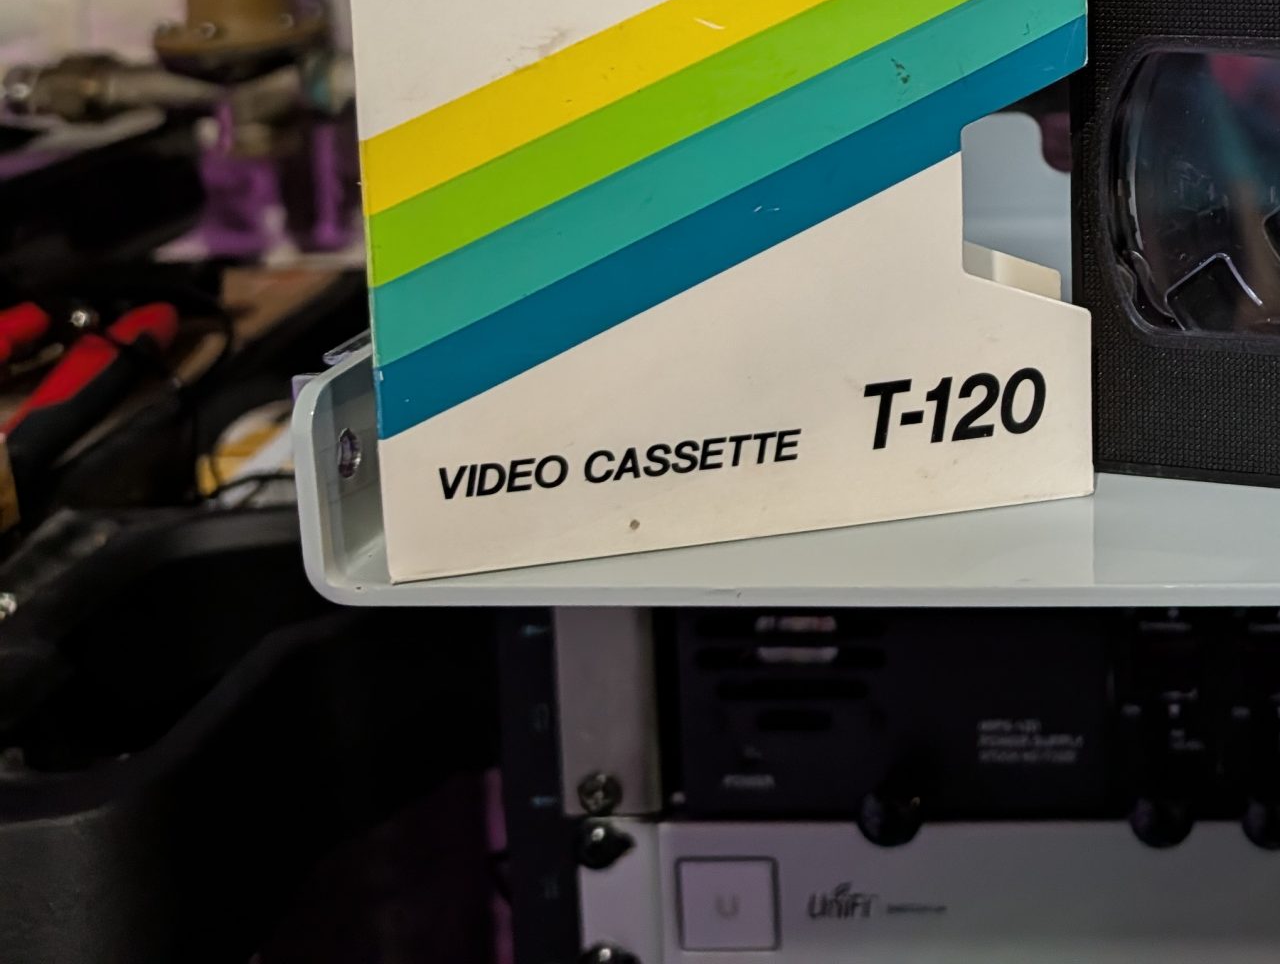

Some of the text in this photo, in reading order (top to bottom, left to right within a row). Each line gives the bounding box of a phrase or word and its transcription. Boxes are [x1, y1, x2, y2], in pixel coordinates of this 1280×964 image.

[863, 367, 1047, 450] T-120
[438, 429, 801, 499] VIDEO CASSETTE
